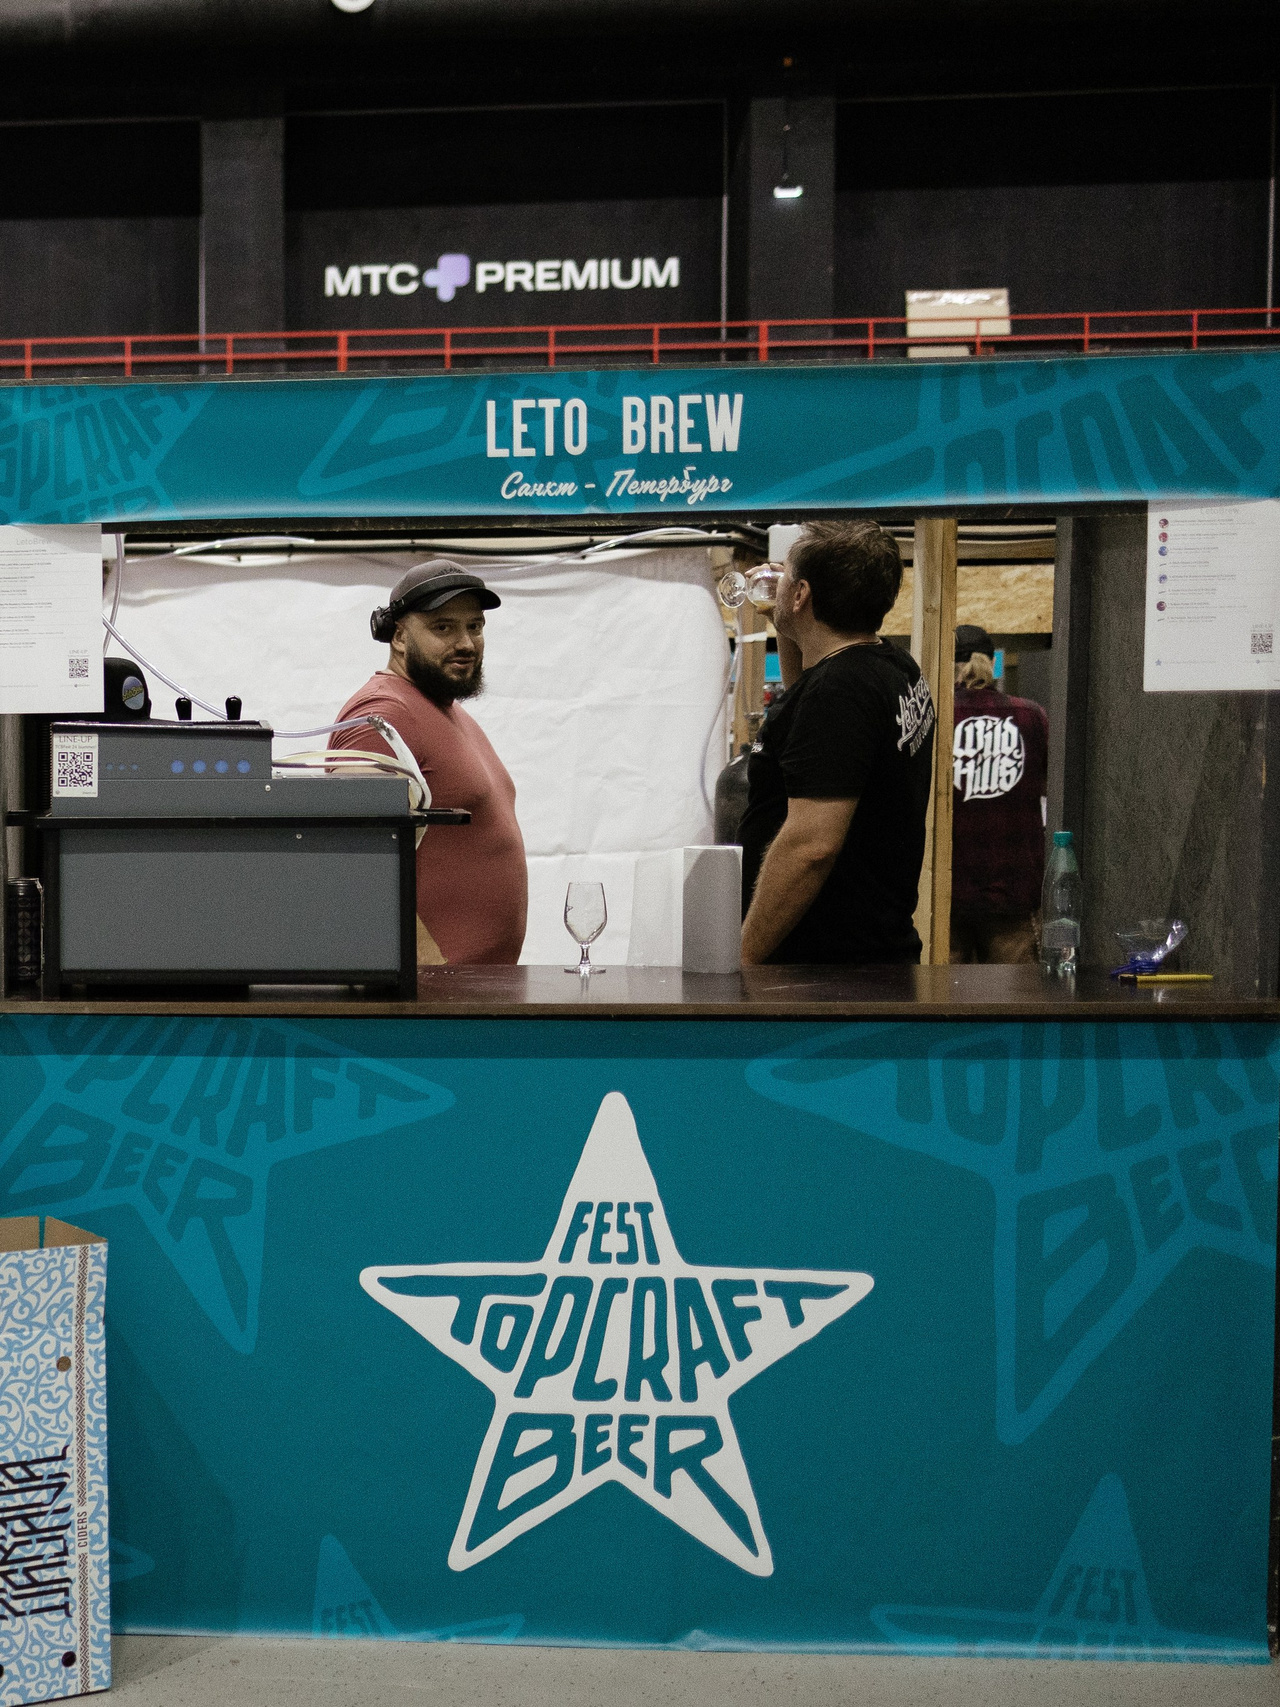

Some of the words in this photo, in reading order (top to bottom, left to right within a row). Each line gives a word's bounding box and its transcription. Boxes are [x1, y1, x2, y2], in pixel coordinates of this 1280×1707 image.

[475, 256, 680, 294] PREMIUM
[486, 398, 588, 458] LETO
[622, 393, 743, 455] BREW
[500, 471, 578, 499] Санкт
[605, 466, 733, 505] Петербург
[557, 1201, 660, 1265] FEST
[376, 1272, 850, 1403] TOPCRAFT
[465, 1411, 760, 1559] BEER
[77, 1511, 87, 1548] CIDERS
[1049, 1565, 1138, 1625] FEST
